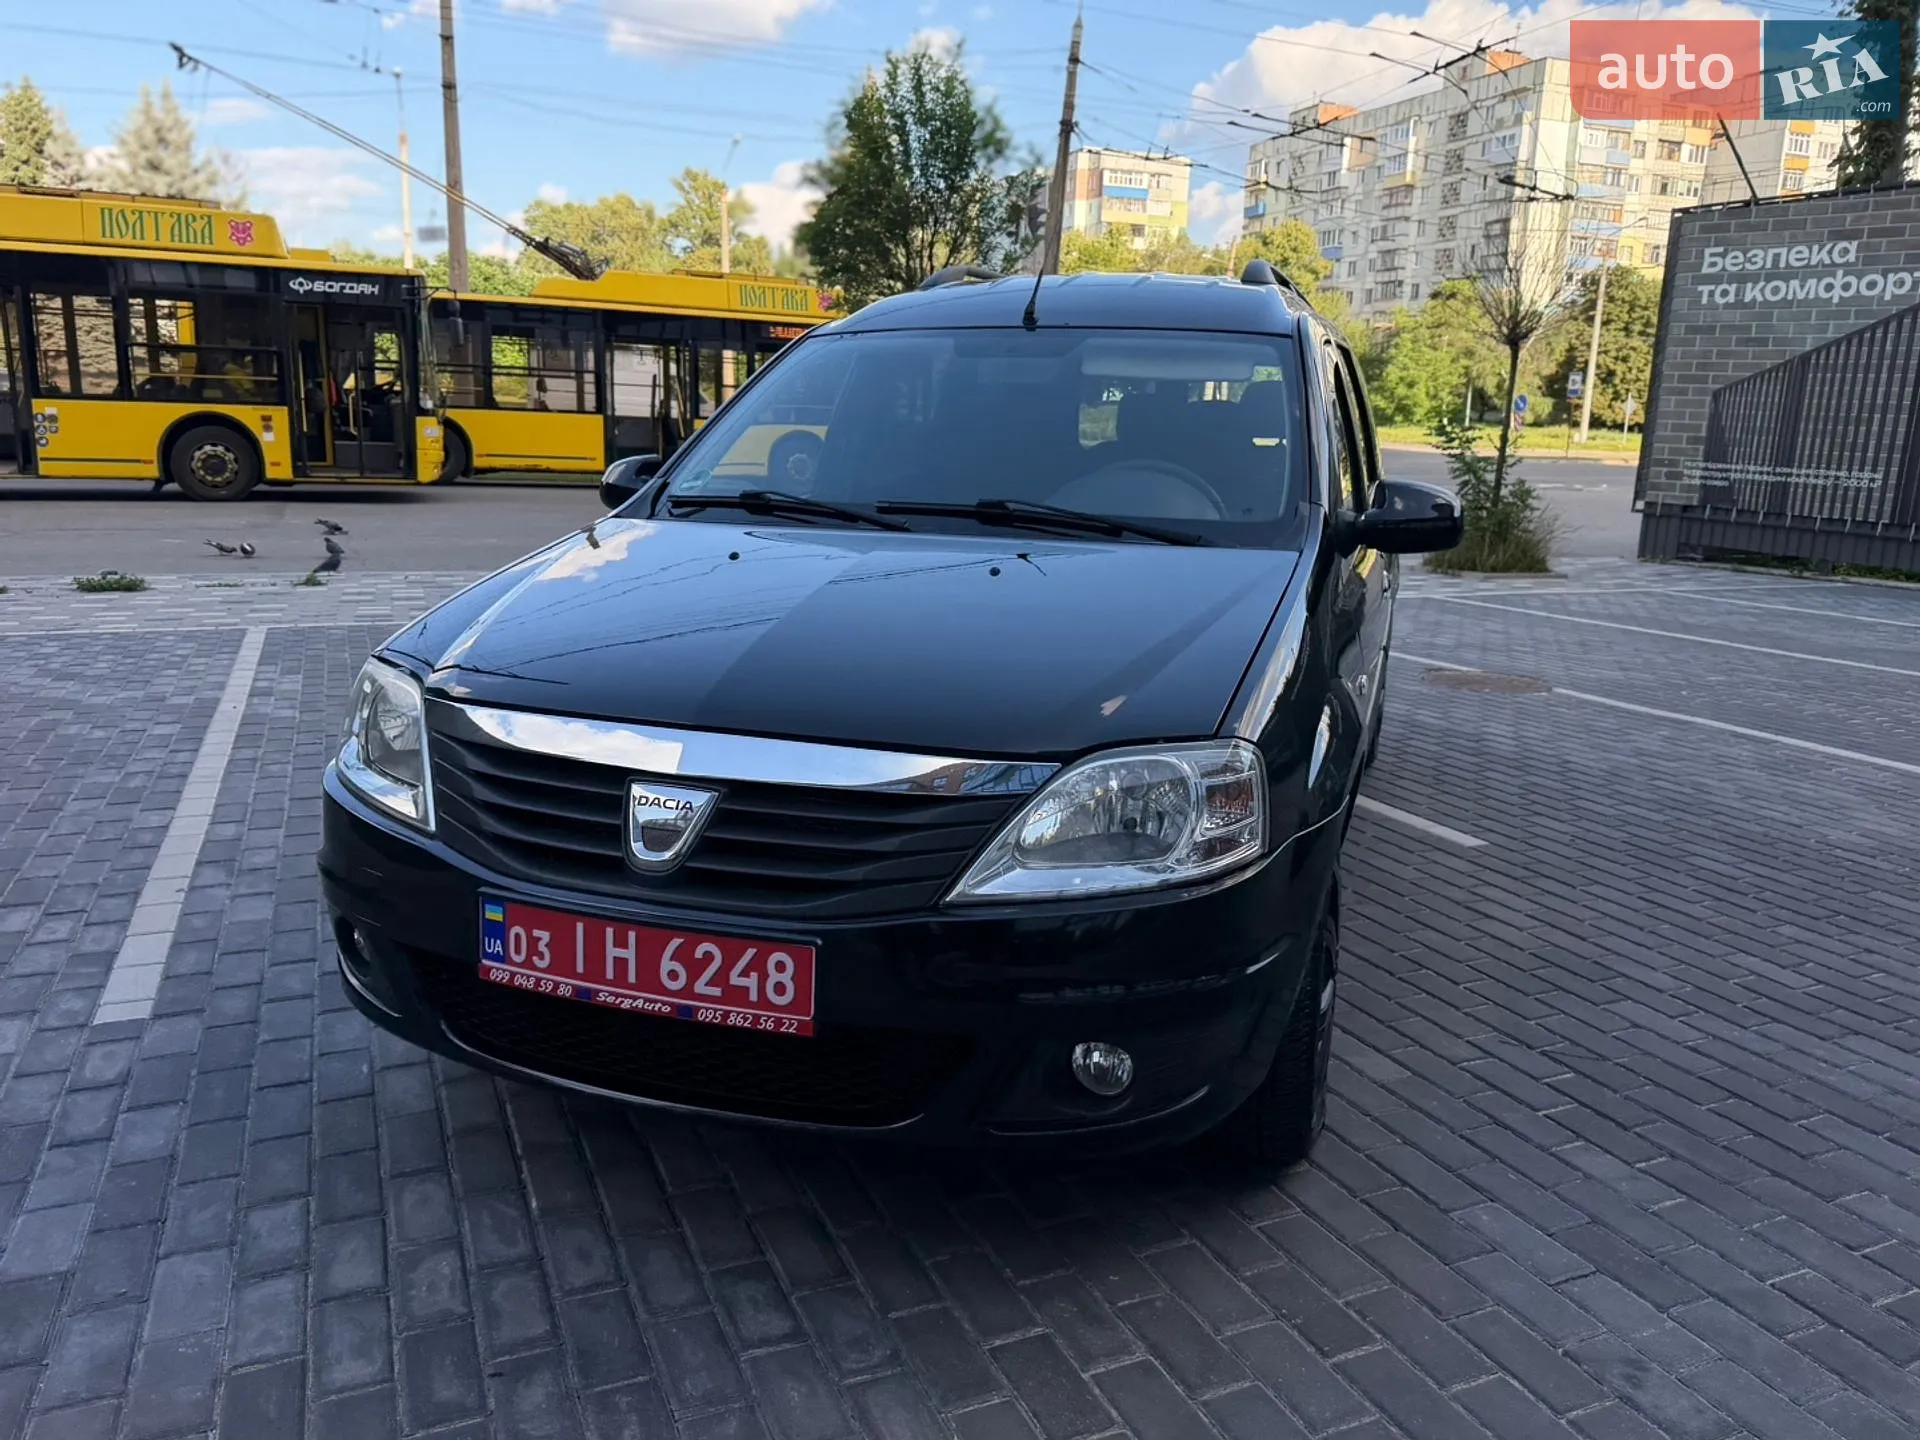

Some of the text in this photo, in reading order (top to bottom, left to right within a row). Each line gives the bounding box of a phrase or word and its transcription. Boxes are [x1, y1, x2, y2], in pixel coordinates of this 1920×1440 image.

[100, 206, 214, 245] ПОЛТАВА
[1701, 240, 1858, 273] Безпека
[312, 281, 379, 295] БОГДАН
[1698, 283, 1736, 304] та
[637, 795, 694, 812] DACIA
[485, 937, 503, 955] UA
[509, 926, 550, 968] 03
[660, 938, 795, 1006] 6248
[489, 968, 572, 997] 099 048 59 80
[596, 991, 671, 1013] SergAuto
[698, 1008, 798, 1033] 095 862 56 22
